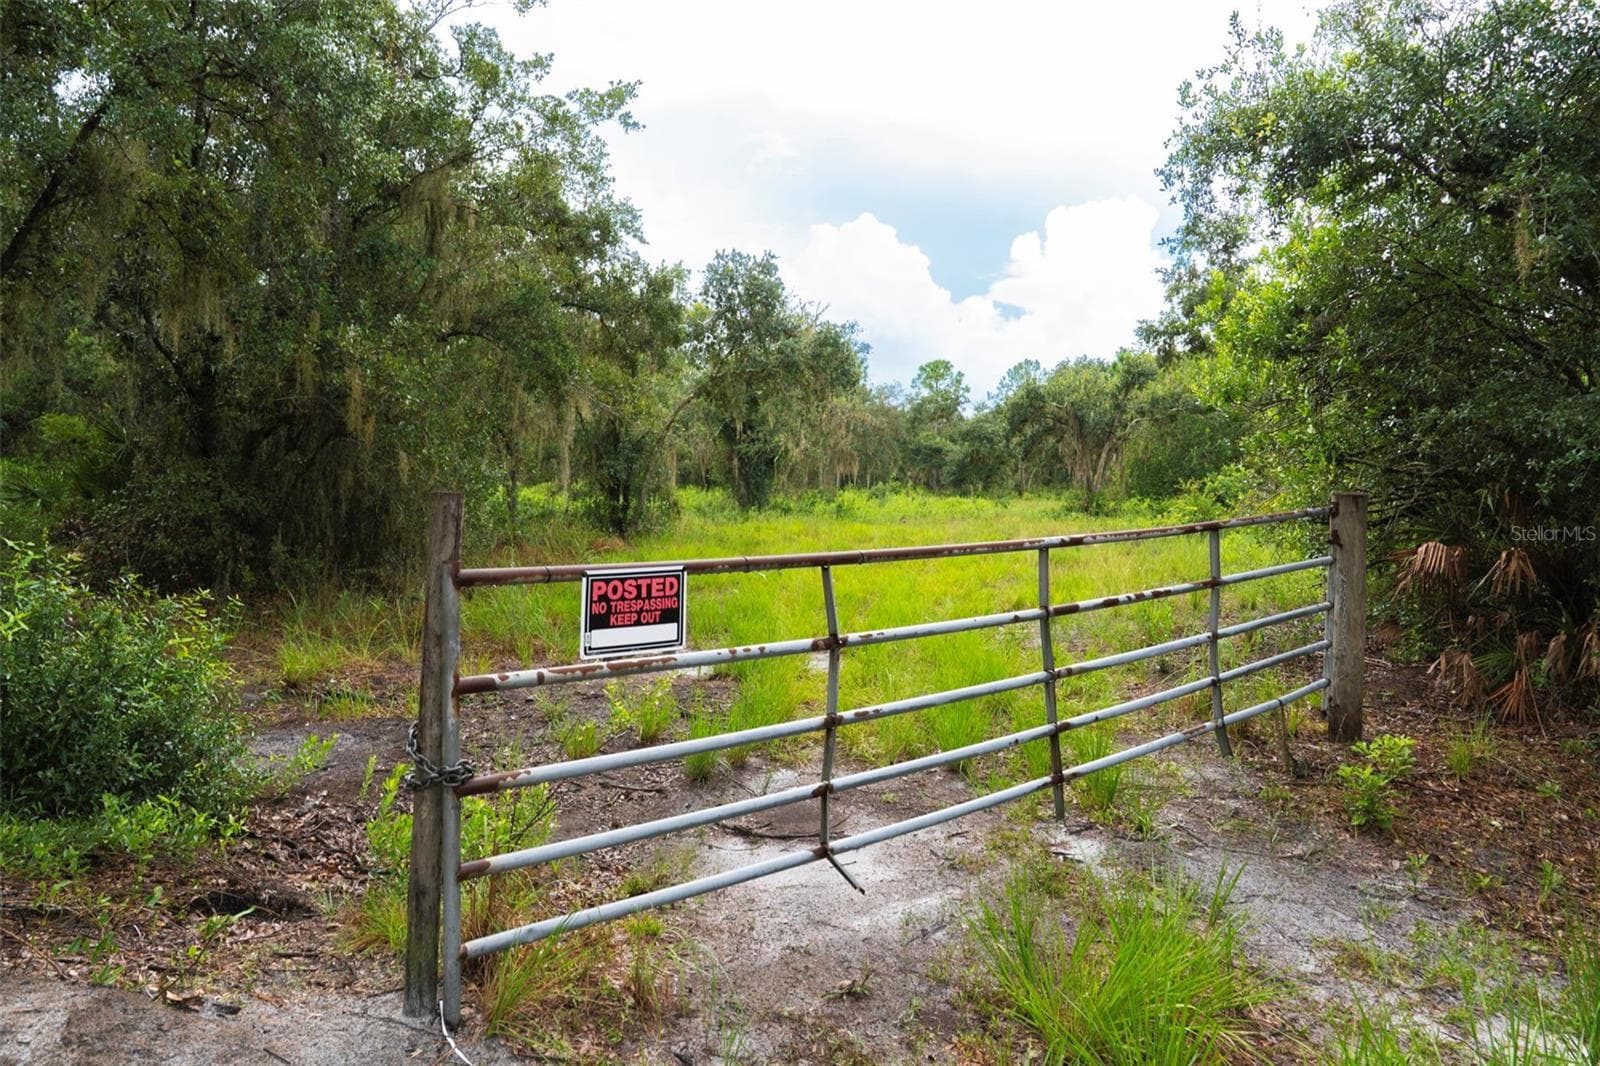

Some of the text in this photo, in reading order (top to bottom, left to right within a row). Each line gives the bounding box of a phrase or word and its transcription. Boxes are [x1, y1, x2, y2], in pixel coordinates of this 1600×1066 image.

[592, 577, 678, 601] POSTED
[592, 597, 678, 615] NO TRESPASSING
[610, 611, 661, 626] KEEP OUT
